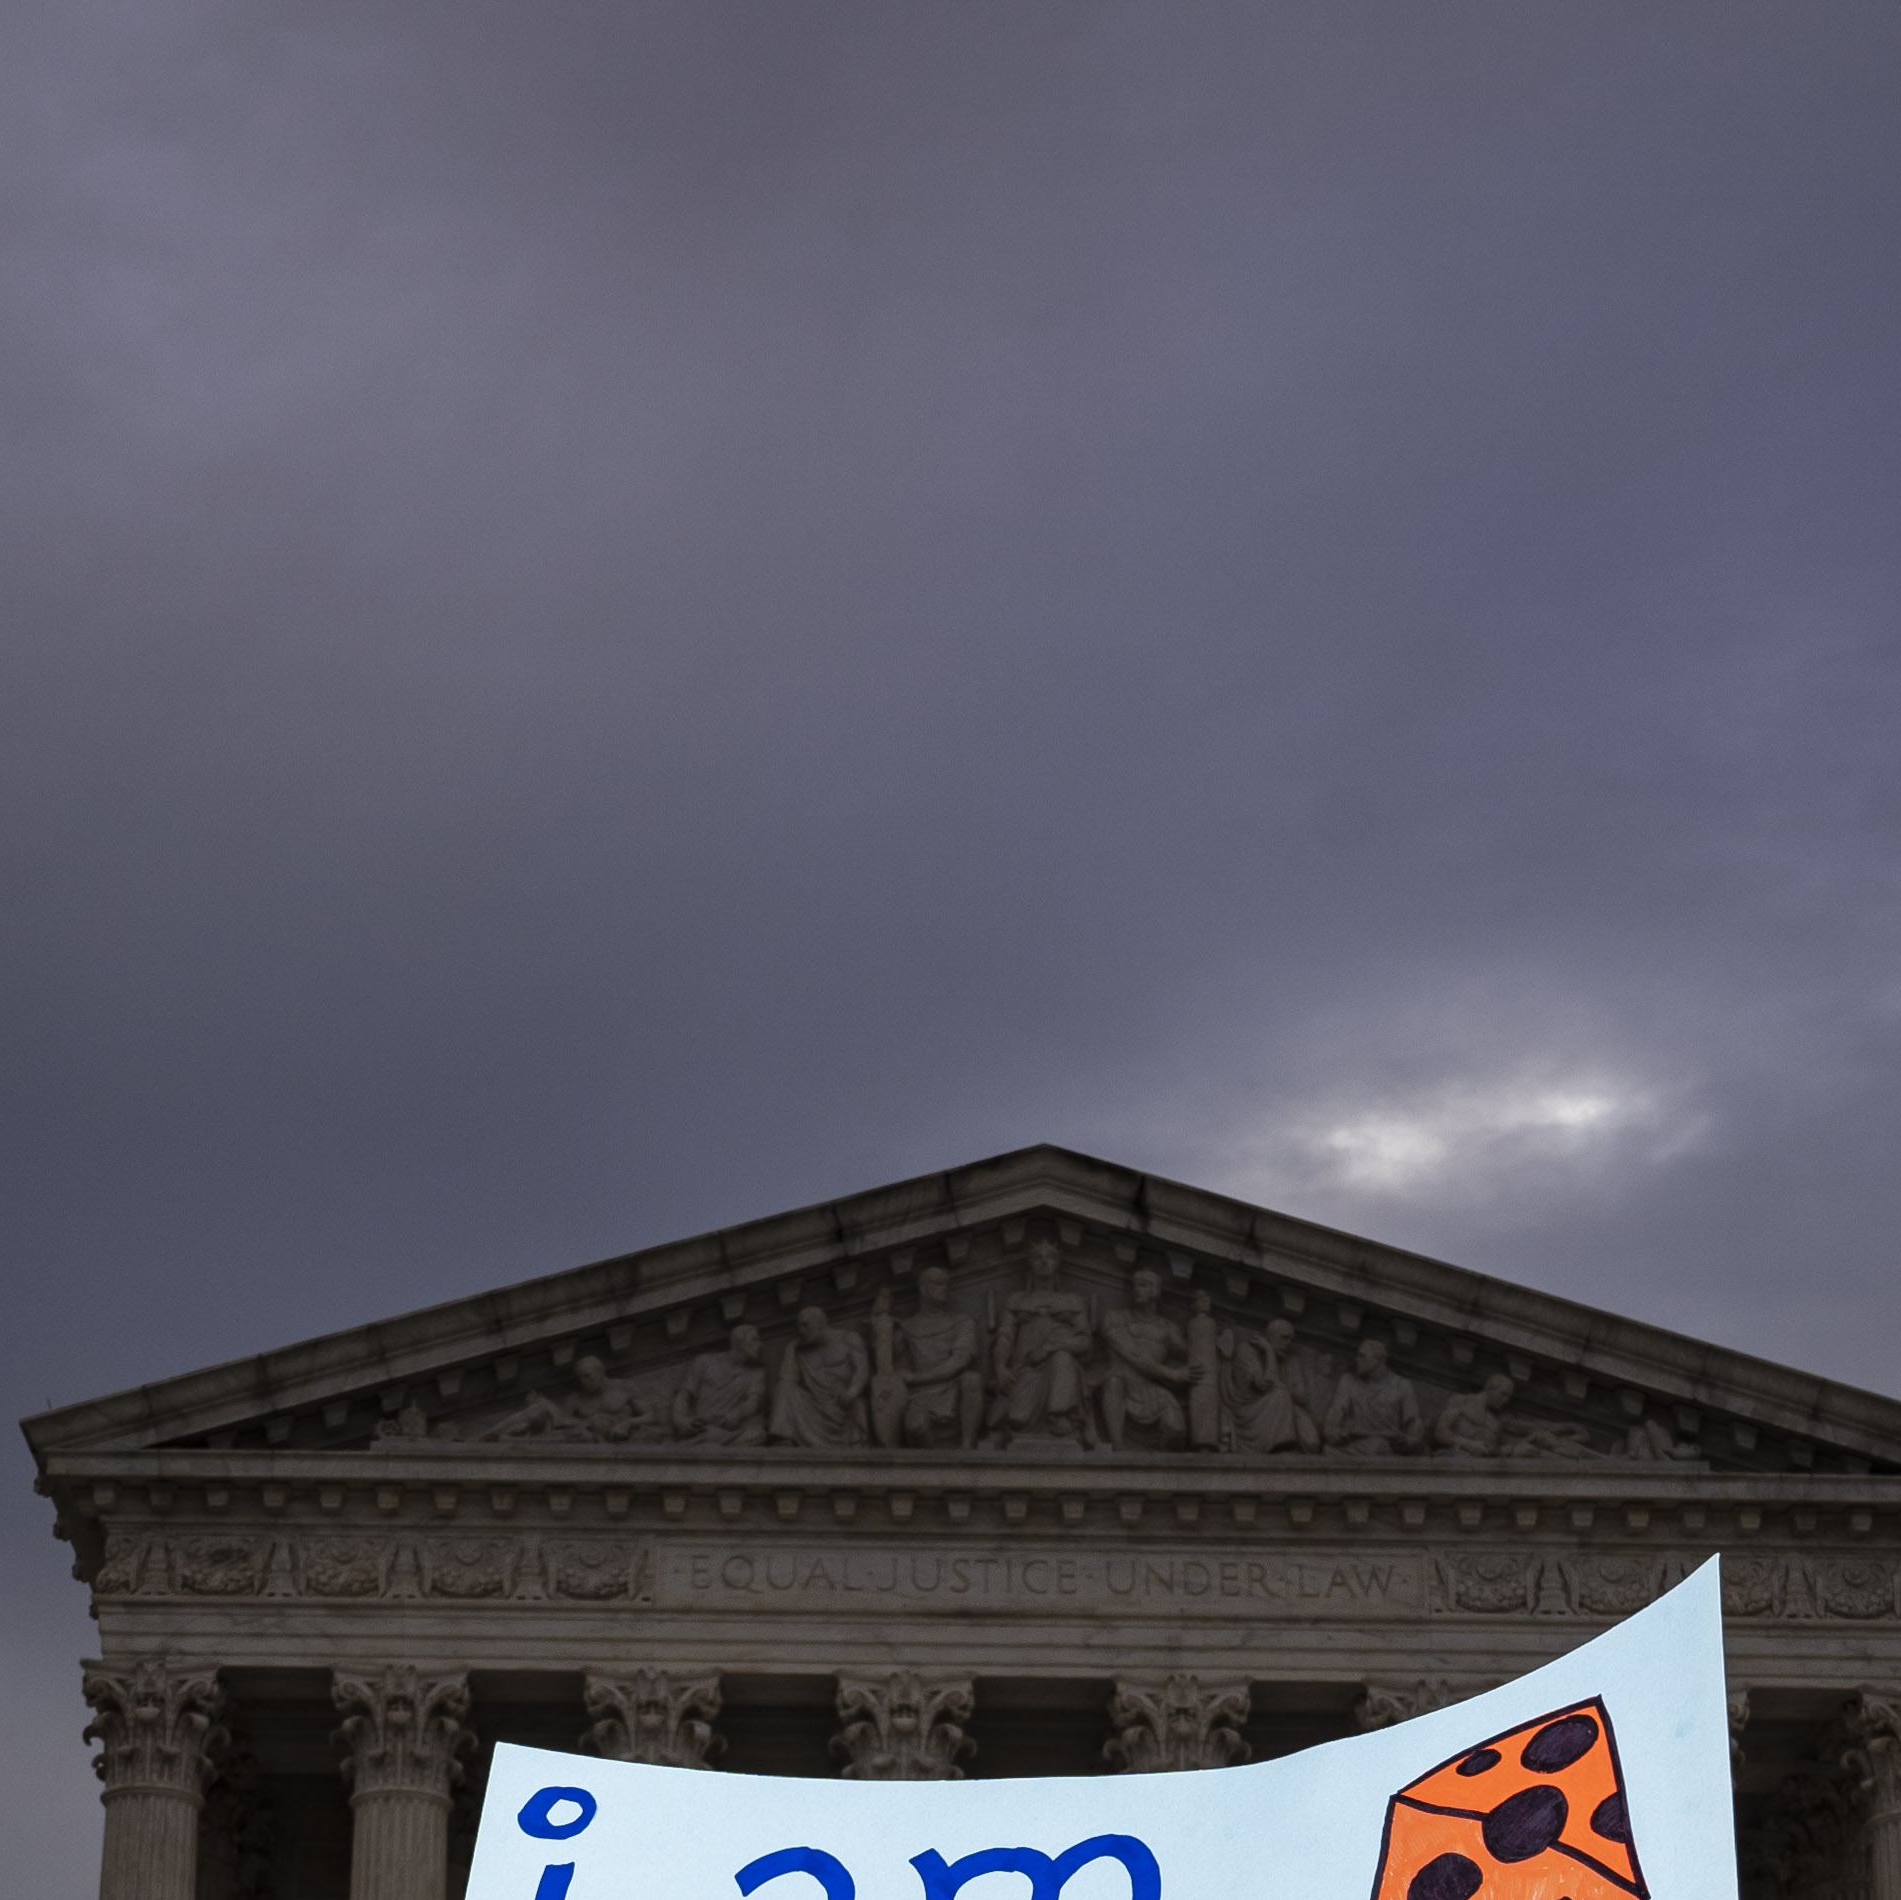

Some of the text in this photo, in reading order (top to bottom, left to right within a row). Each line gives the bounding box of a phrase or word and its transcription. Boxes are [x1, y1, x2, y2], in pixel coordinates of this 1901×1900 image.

[690, 1554, 1393, 1597] EQUAL JUSTICE UNDER LAW
